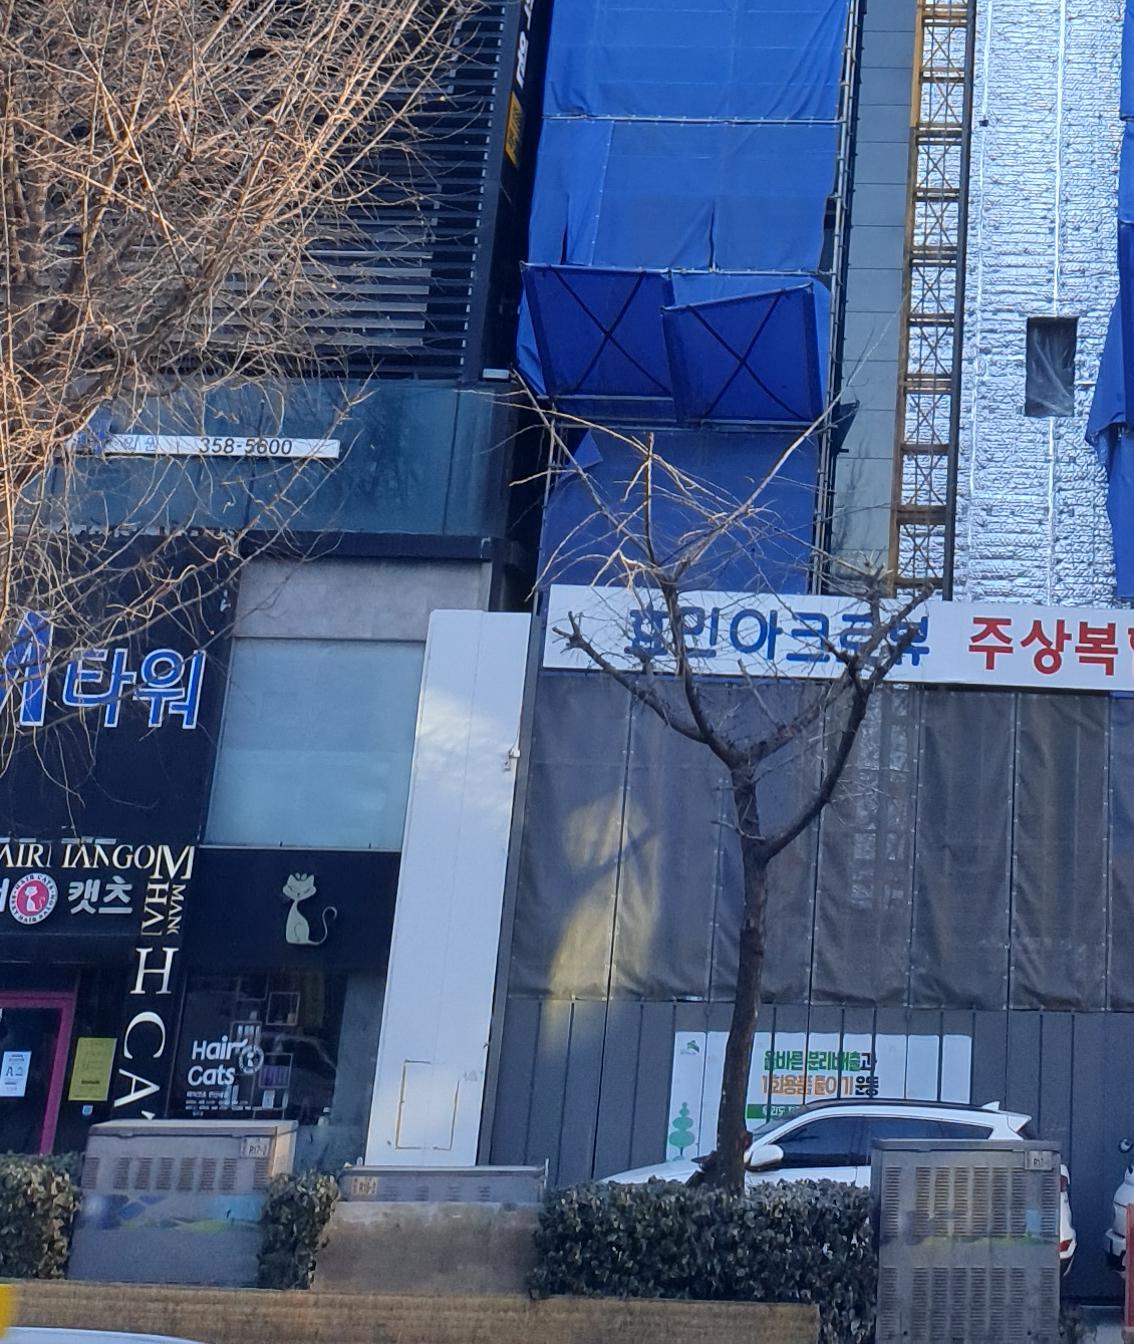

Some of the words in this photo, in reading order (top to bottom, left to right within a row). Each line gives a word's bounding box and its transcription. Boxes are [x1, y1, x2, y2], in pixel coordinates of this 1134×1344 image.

[199, 436, 293, 456] 358-5600
[68, 876, 133, 915] 캣츠
[191, 1034, 249, 1061] Hair
[187, 1064, 236, 1086] Cats
